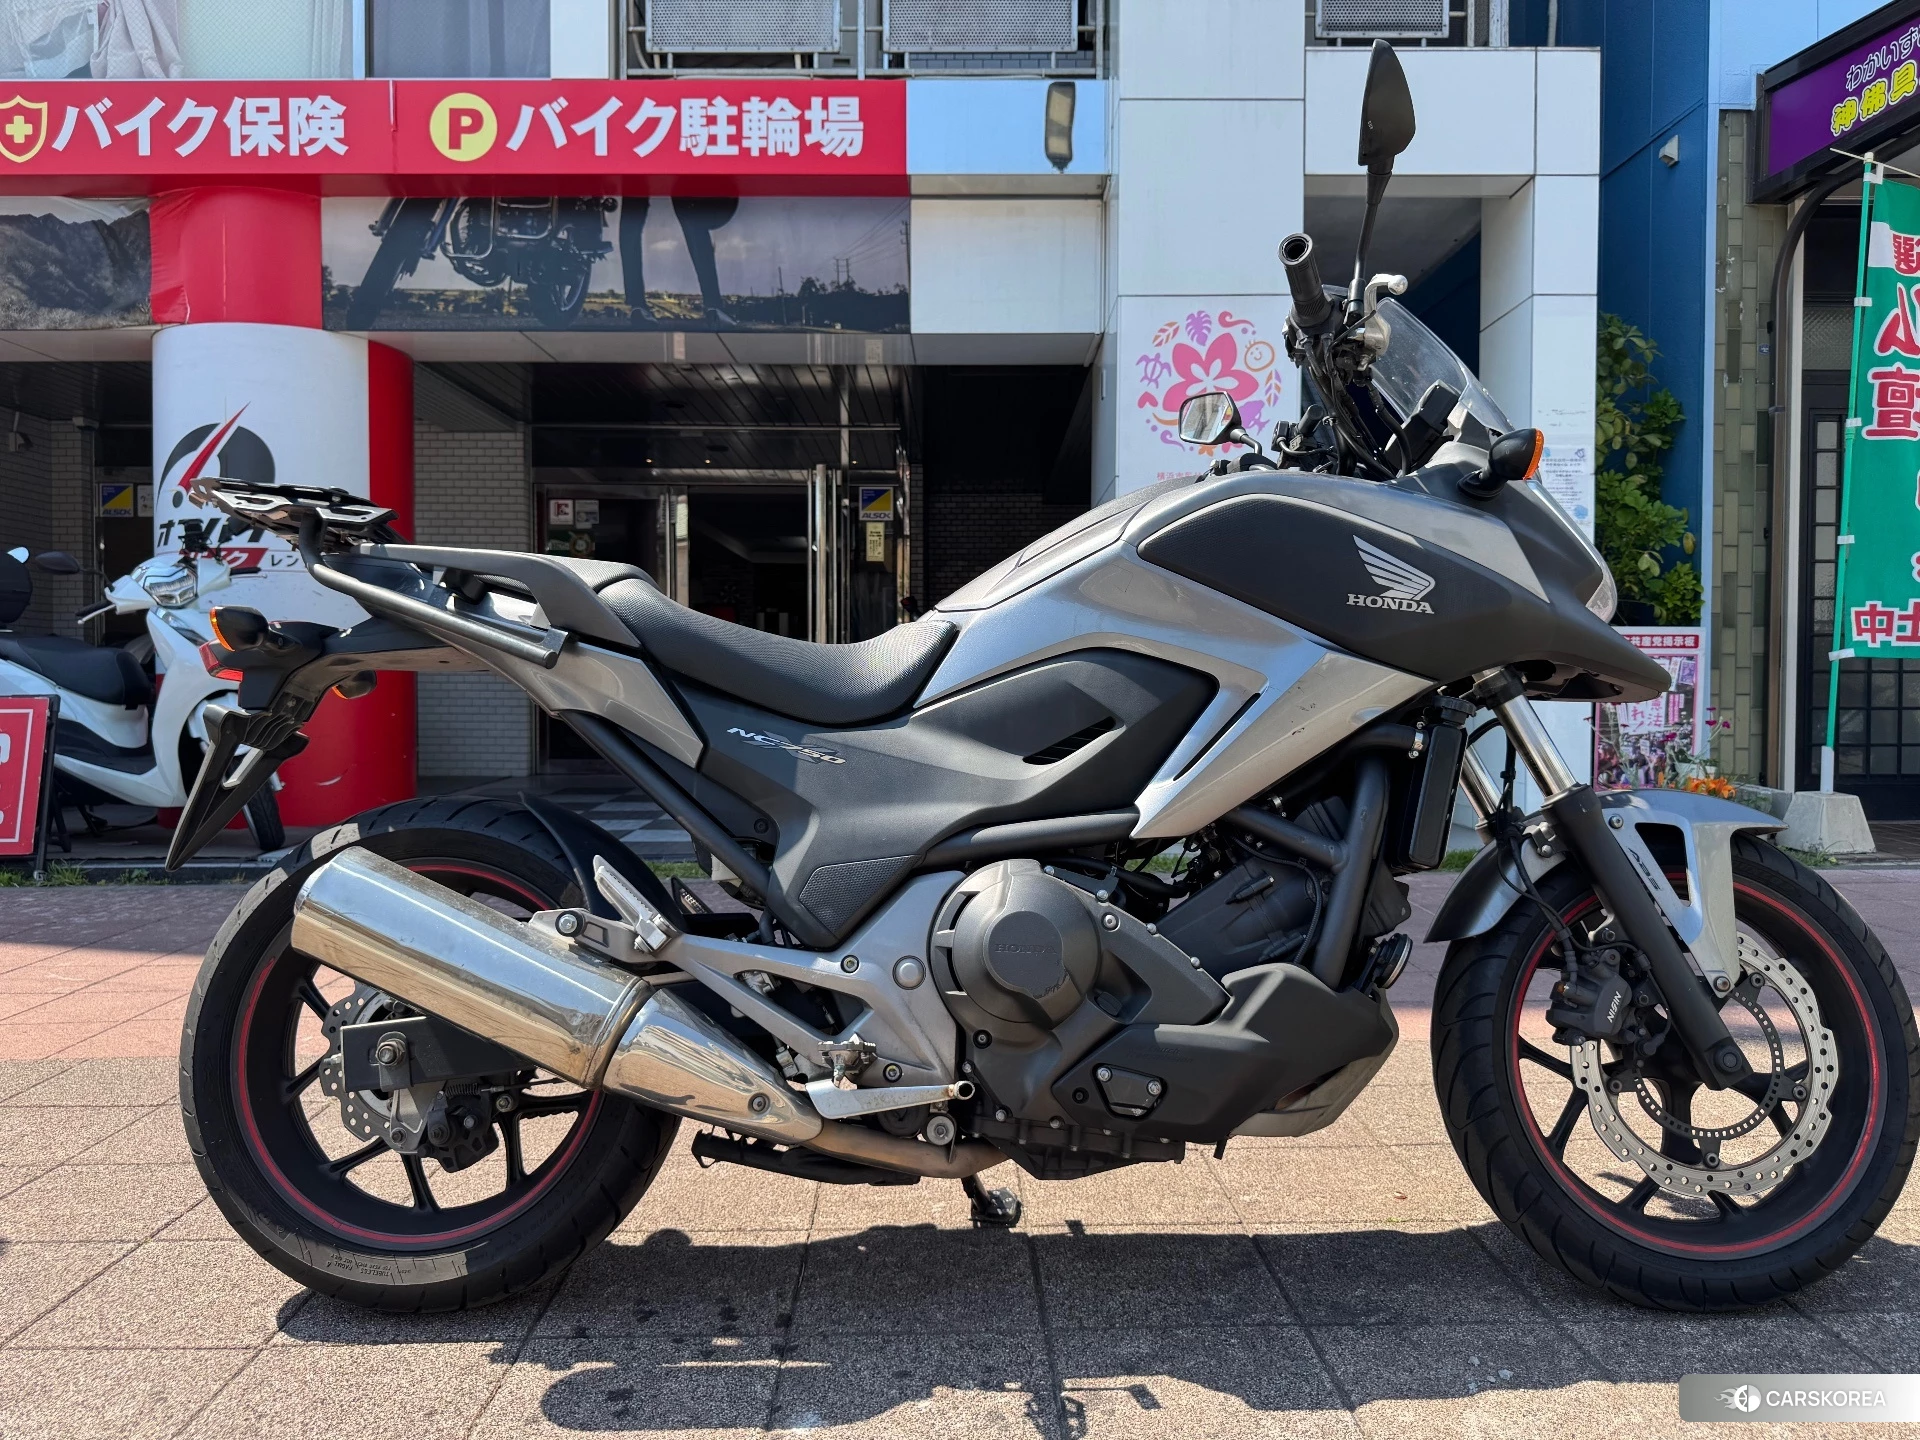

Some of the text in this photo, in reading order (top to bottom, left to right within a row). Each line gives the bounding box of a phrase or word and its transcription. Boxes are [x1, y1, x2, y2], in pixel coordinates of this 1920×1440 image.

[1845, 23, 1920, 92] わかいず
[51, 95, 349, 157] バイク保険
[448, 107, 484, 150] P
[506, 95, 864, 158] バイク駐輪場
[1346, 593, 1435, 614] HONDA
[1624, 635, 1696, 647] 共産党掲示板
